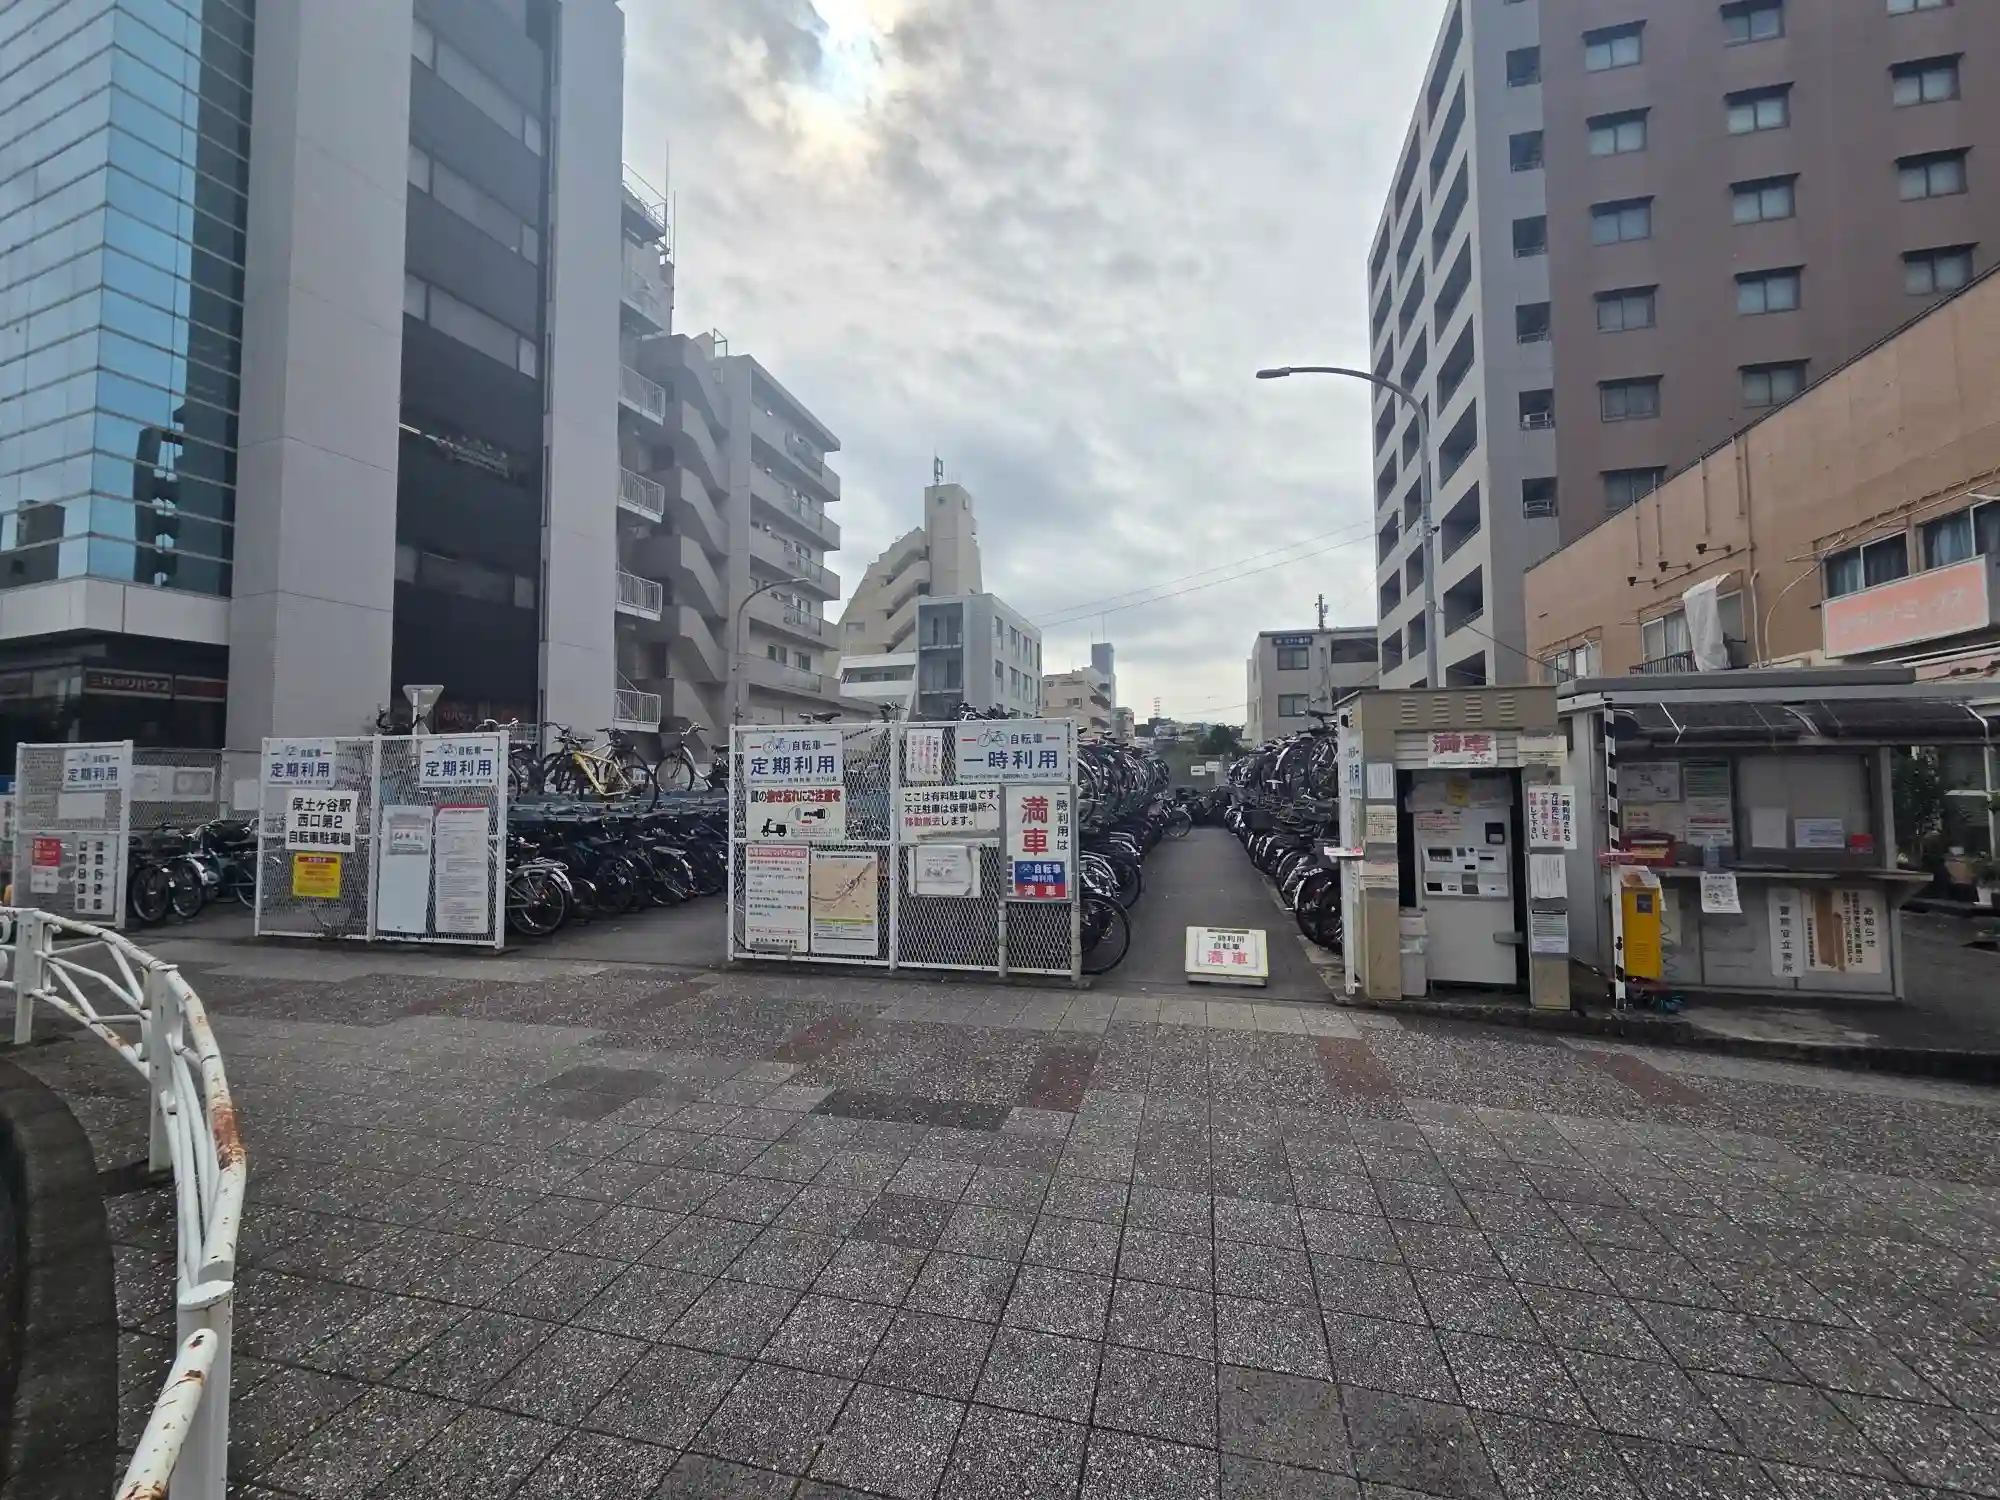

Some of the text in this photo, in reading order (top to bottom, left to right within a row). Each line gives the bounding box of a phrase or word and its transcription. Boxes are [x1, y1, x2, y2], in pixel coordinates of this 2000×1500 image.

[792, 740, 821, 751] 自転車
[1010, 733, 1043, 745] 自転車
[1432, 734, 1492, 753] 満車
[459, 745, 481, 756] 自転車
[750, 755, 835, 776] 定期利用
[963, 749, 1058, 770] 一時利用
[68, 767, 118, 781] 定期利用
[271, 761, 329, 778] 定期利用
[425, 759, 491, 776] 定期利用
[904, 789, 1000, 802] ここは有料駐車場です。
[292, 797, 351, 812] 保土ヶ谷駅
[904, 802, 997, 815] 不正駐車は保管場所へ
[297, 813, 343, 828] 西口第2
[1021, 795, 1049, 856] 満車
[1056, 792, 1069, 850] 一時利用は
[289, 831, 351, 845] 自転車駐車場
[1034, 863, 1061, 874] 自転車
[1024, 885, 1056, 897] 満車
[1863, 907, 1876, 948] お知らせ
[1214, 942, 1240, 950] 自転車
[1208, 951, 1248, 965] 満車
